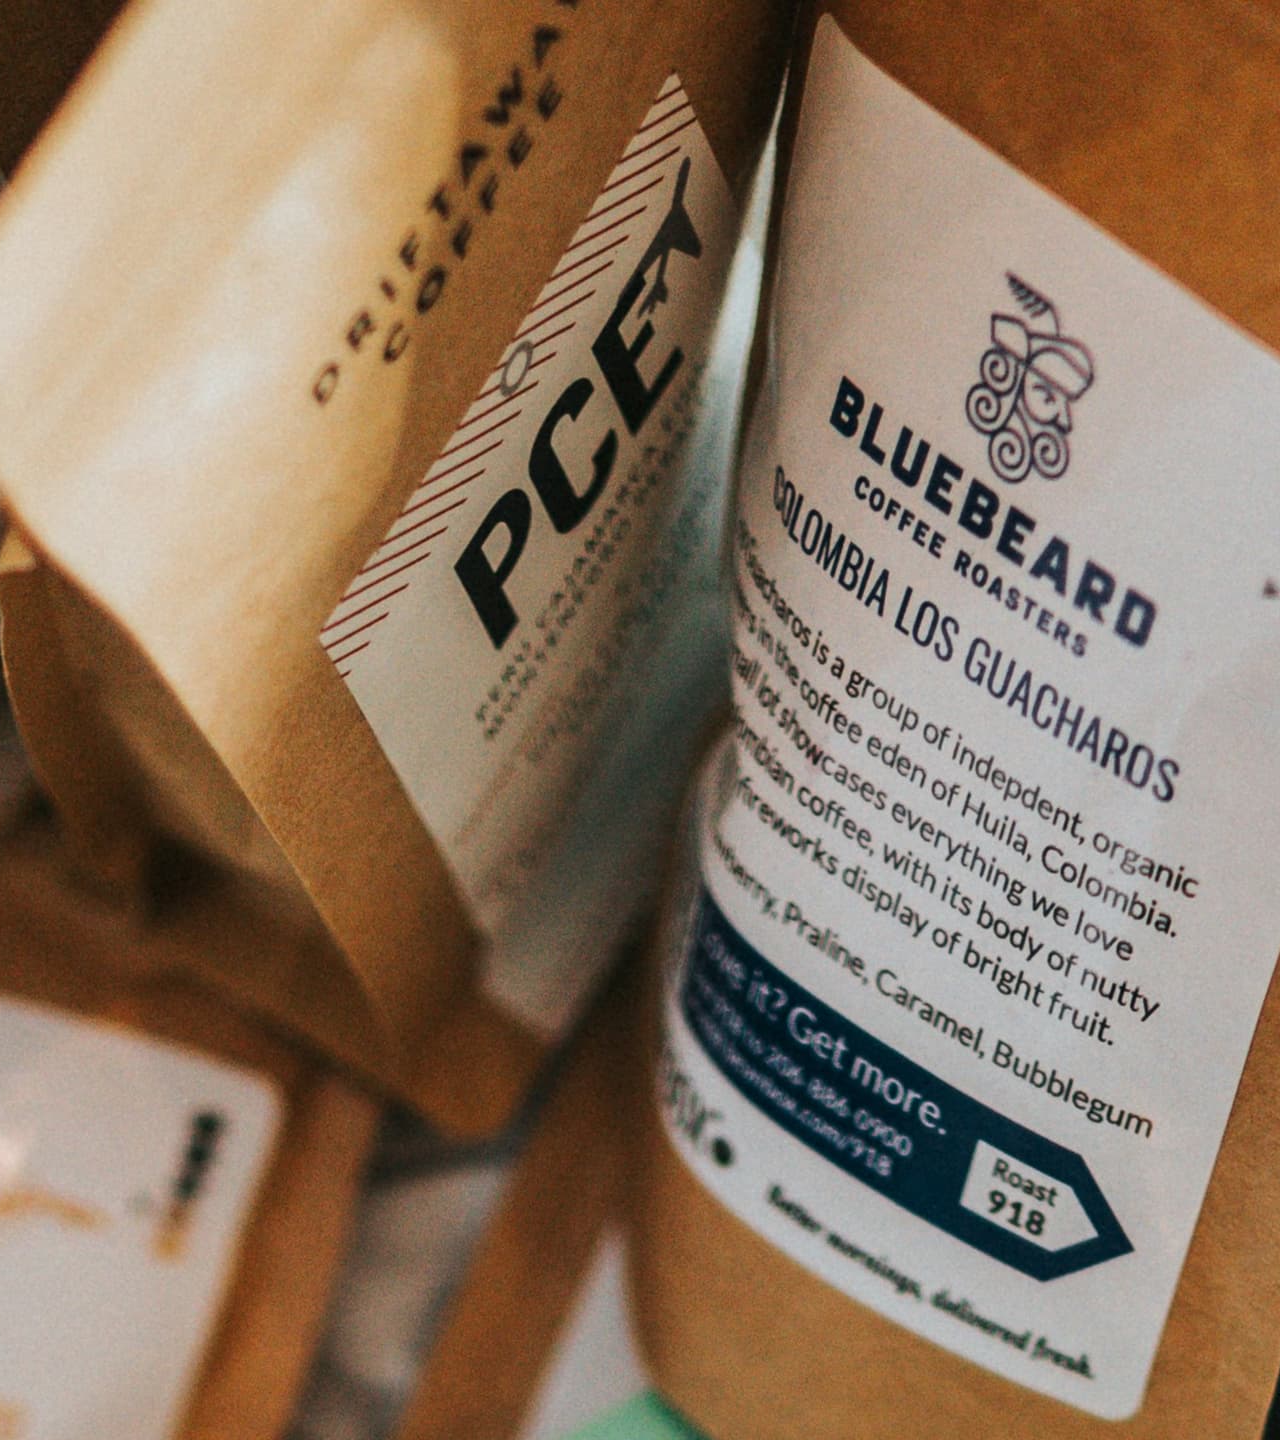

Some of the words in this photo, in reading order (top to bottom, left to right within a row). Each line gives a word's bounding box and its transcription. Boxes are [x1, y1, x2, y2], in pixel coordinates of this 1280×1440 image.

[311, 0, 582, 405] DRIFTAWA
[828, 375, 1159, 648] BLUEBEARD
[852, 474, 943, 558] COFFEE
[953, 549, 1089, 658] ROASTERS
[771, 465, 889, 617] COLOMBIA
[894, 586, 960, 663] LOS
[963, 636, 1182, 805] GUACHAROS
[777, 708, 886, 811] showcases
[892, 803, 1027, 907] everything
[1030, 892, 1070, 927] we
[1074, 911, 1136, 962] love
[800, 678, 862, 745] coffee
[867, 737, 927, 789] eden
[931, 780, 962, 808] of
[962, 794, 1032, 863] Huila,
[1041, 846, 1178, 940] Colombia.
[812, 630, 829, 665] is
[831, 656, 845, 679] a
[845, 669, 919, 732] group
[924, 721, 950, 750] of
[952, 733, 1086, 845] indepdent,
[1092, 830, 1201, 899] organic
[783, 900, 869, 985] Praline,
[875, 967, 987, 1058] Caramel,
[992, 1039, 1155, 1138] Bubblegum
[797, 787, 874, 857] coffee,
[882, 843, 937, 894] with
[941, 875, 973, 916] its
[977, 899, 1044, 962] body
[1047, 950, 1078, 978] of
[1082, 965, 1161, 1023] nutty
[842, 864, 928, 938] display
[932, 929, 963, 956] of
[964, 938, 1045, 1012] bright
[1047, 993, 1115, 1047] fruit.
[787, 1006, 848, 1070] Get
[851, 1056, 948, 1136] more.
[991, 1155, 1059, 1211] Roast
[987, 1187, 1046, 1238] 918
